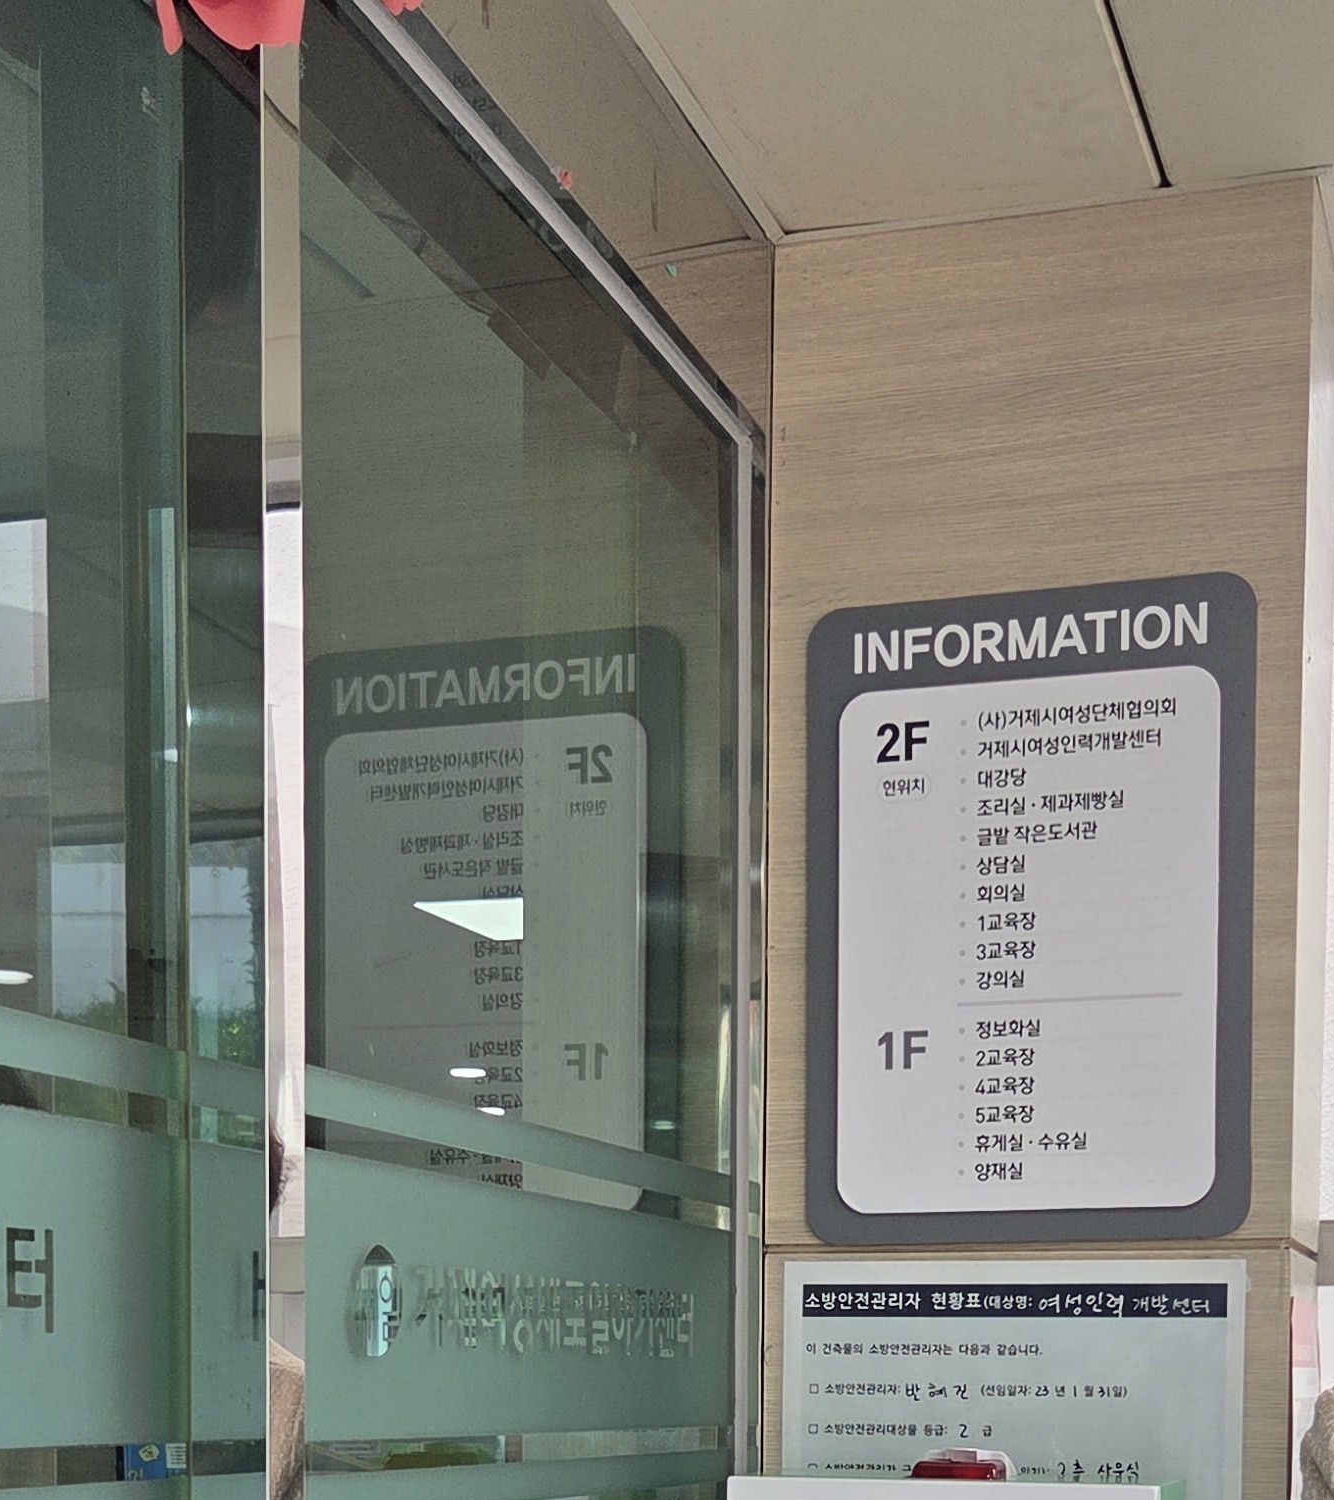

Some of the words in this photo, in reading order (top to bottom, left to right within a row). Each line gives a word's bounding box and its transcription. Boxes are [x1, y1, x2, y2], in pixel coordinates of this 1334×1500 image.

[853, 602, 1209, 675] INFORMATION
[978, 697, 1177, 731] (사)거제시여성단체협의회
[876, 720, 930, 764] 2F
[977, 728, 1162, 759] 거제시여성인력개발센터
[977, 767, 1027, 789] 대강당
[976, 796, 1026, 817] 조리실
[1040, 789, 1125, 813] 제과제빵실
[1013, 821, 1098, 844] 작은도서관
[976, 854, 1026, 876] 상담실
[976, 883, 1026, 904] 회의실
[976, 912, 1036, 933] 1교육장
[975, 940, 1036, 961] 3교육장
[975, 970, 1026, 990] 강의실
[975, 1018, 1042, 1040] 정보화실
[877, 1029, 929, 1071] 1F
[975, 1048, 1035, 1068] 2교육장
[974, 1076, 1035, 1097] 4교육장
[974, 1105, 1035, 1125] 5교육장
[974, 1132, 1024, 1153] 휴게실
[1038, 1131, 1088, 1152] 수유실
[974, 1161, 1023, 1182] 양재실
[804, 1291, 922, 1311] 소방안전관리자
[806, 1343, 816, 1355] 이
[868, 1343, 954, 1356] 소방안전관리자는
[958, 1344, 991, 1356] 다음과
[996, 1344, 1044, 1357] 같습니다.
